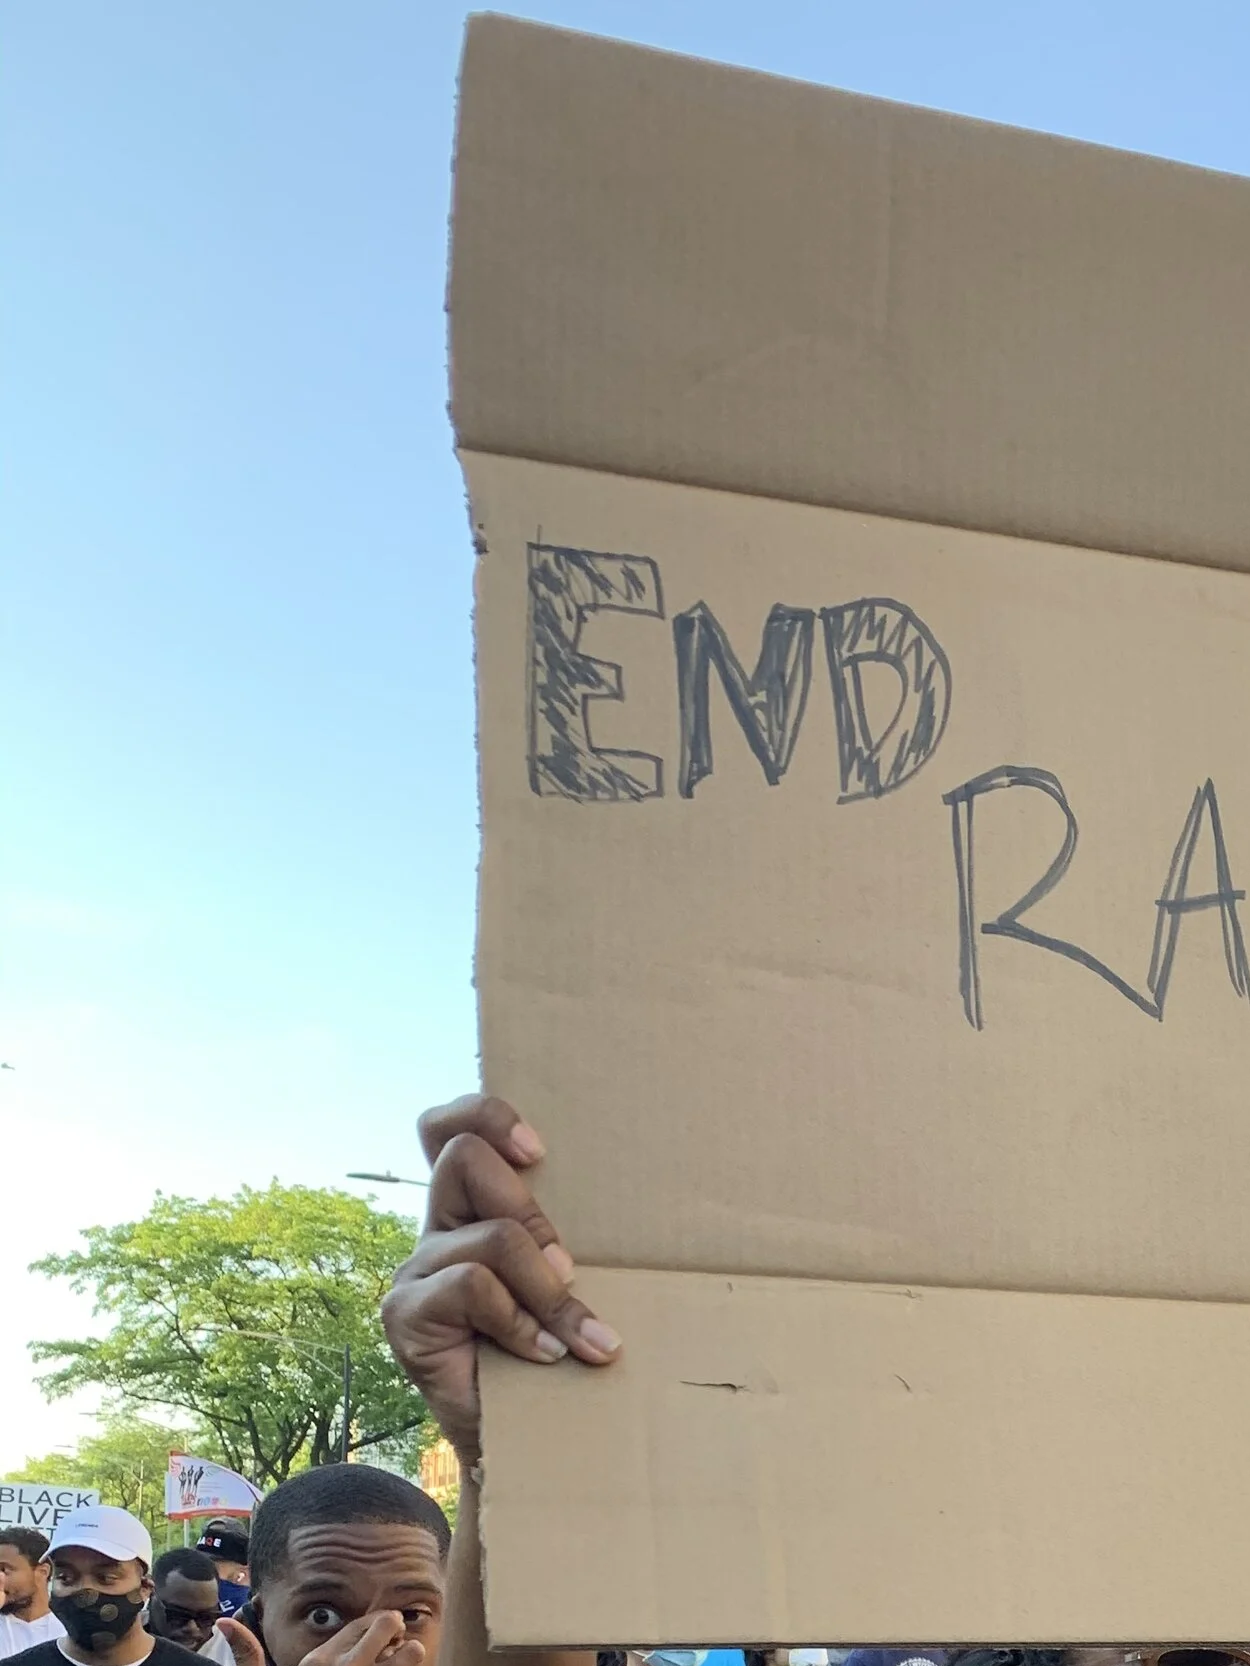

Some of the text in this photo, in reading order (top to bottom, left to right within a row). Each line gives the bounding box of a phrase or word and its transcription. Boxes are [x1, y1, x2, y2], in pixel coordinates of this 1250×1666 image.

[526, 534, 951, 804] END
[0, 1487, 93, 1508] BLACK
[0, 1504, 72, 1526] LIVE
